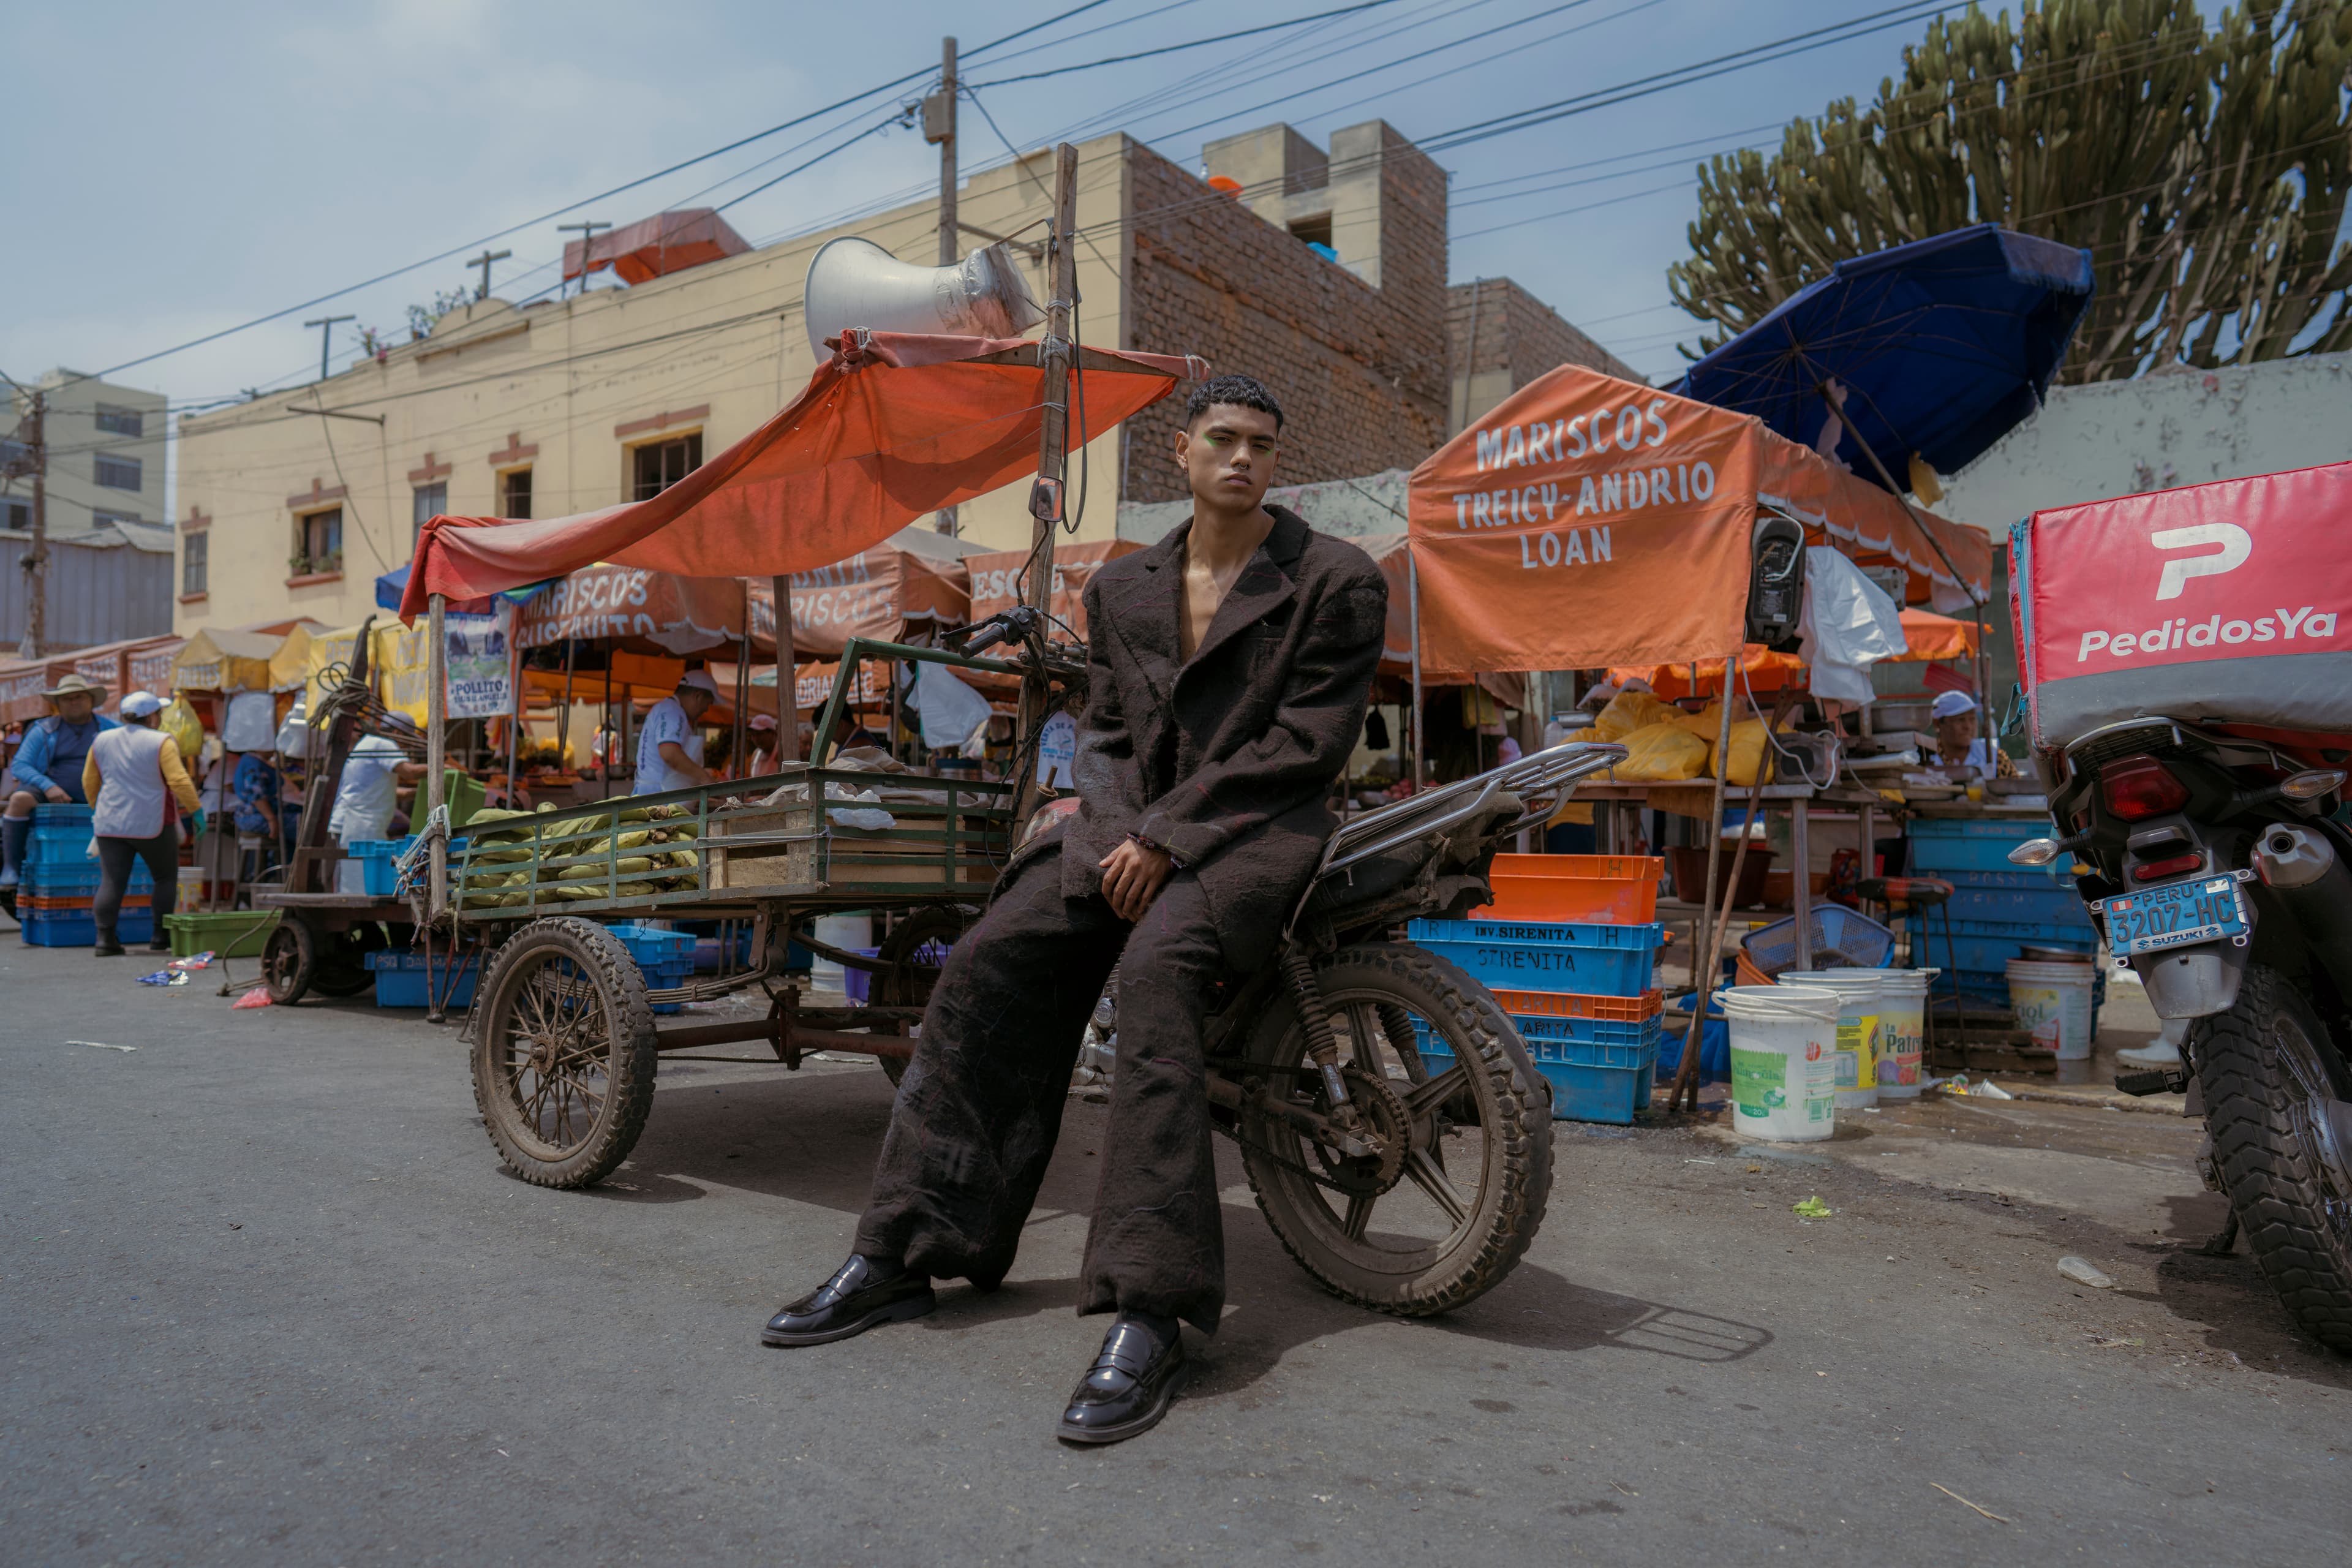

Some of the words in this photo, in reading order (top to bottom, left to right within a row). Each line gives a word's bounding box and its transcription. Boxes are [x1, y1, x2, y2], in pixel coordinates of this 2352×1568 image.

[1476, 399, 1667, 472] MARISCOS
[1519, 526, 1612, 569] LOAN
[752, 587, 892, 635] MRISCOS
[2077, 606, 2338, 662] PedidosYa
[456, 680, 503, 695] POLLITO
[2143, 885, 2193, 907] PERU
[2114, 892, 2234, 943] 3207-HC
[1605, 927, 1619, 945] H
[2152, 930, 2204, 946] SUZUKI
[1478, 949, 1576, 972] SIRENITA
[1605, 1045, 1616, 1064] L
